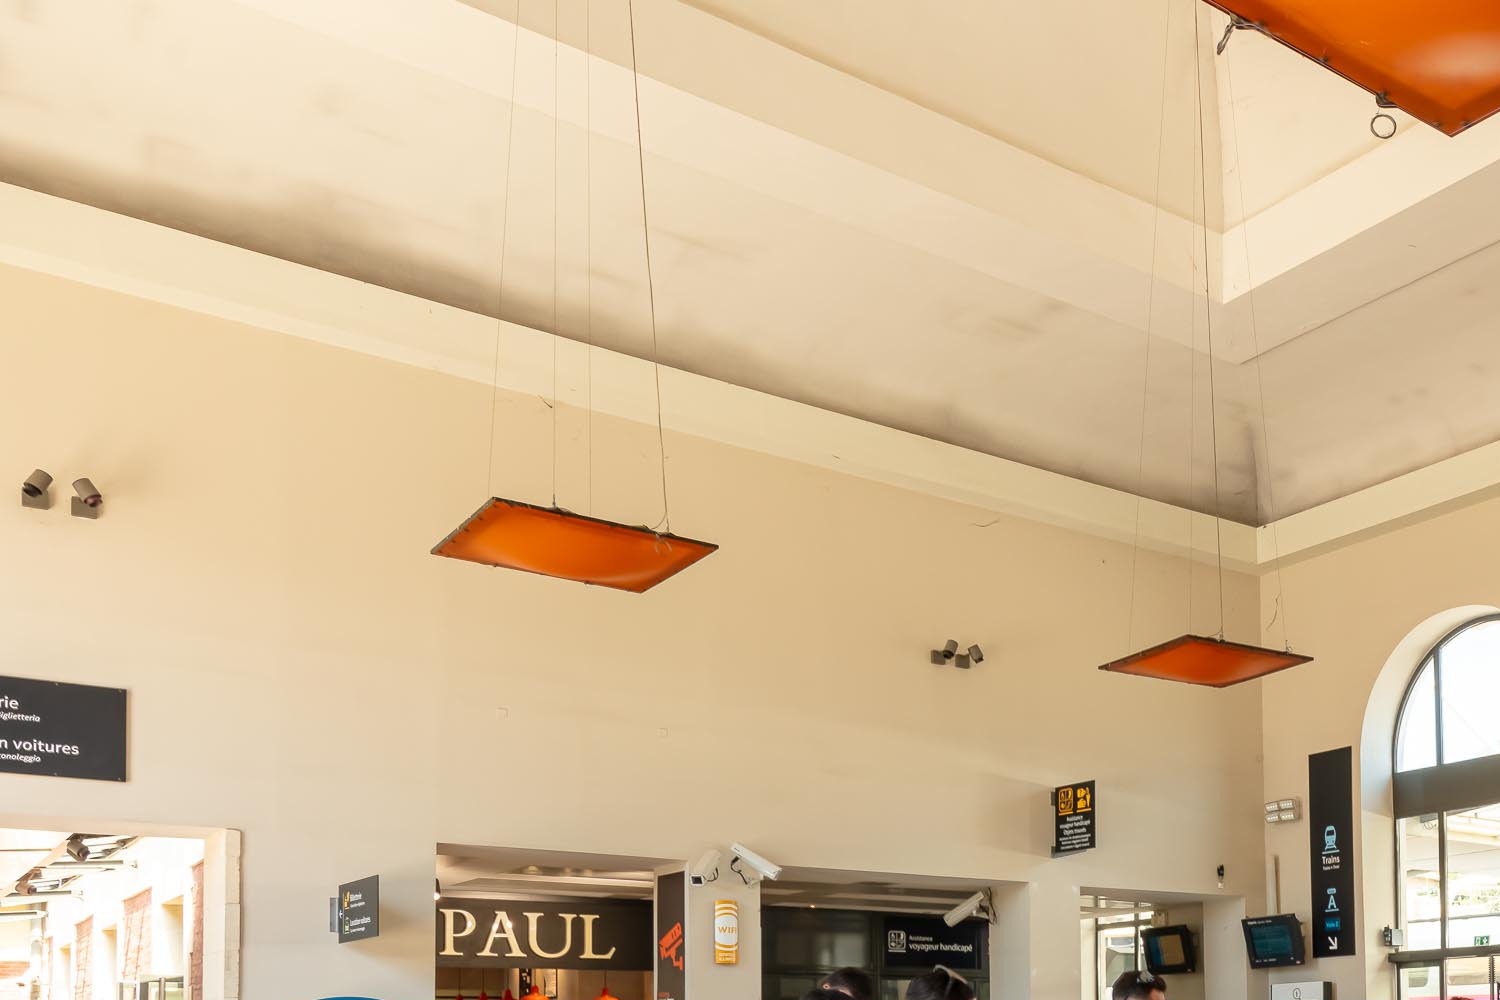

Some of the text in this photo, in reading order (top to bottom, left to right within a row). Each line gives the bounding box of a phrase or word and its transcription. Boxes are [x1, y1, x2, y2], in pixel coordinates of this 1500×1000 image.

[0, 696, 19, 710] rie
[0, 711, 41, 723] iglietteria
[13, 738, 80, 756] voitures
[1322, 856, 1340, 864] Trains
[1327, 894, 1337, 909] A
[439, 908, 616, 960] PAUL
[909, 942, 973, 953] voyageur handicapé
